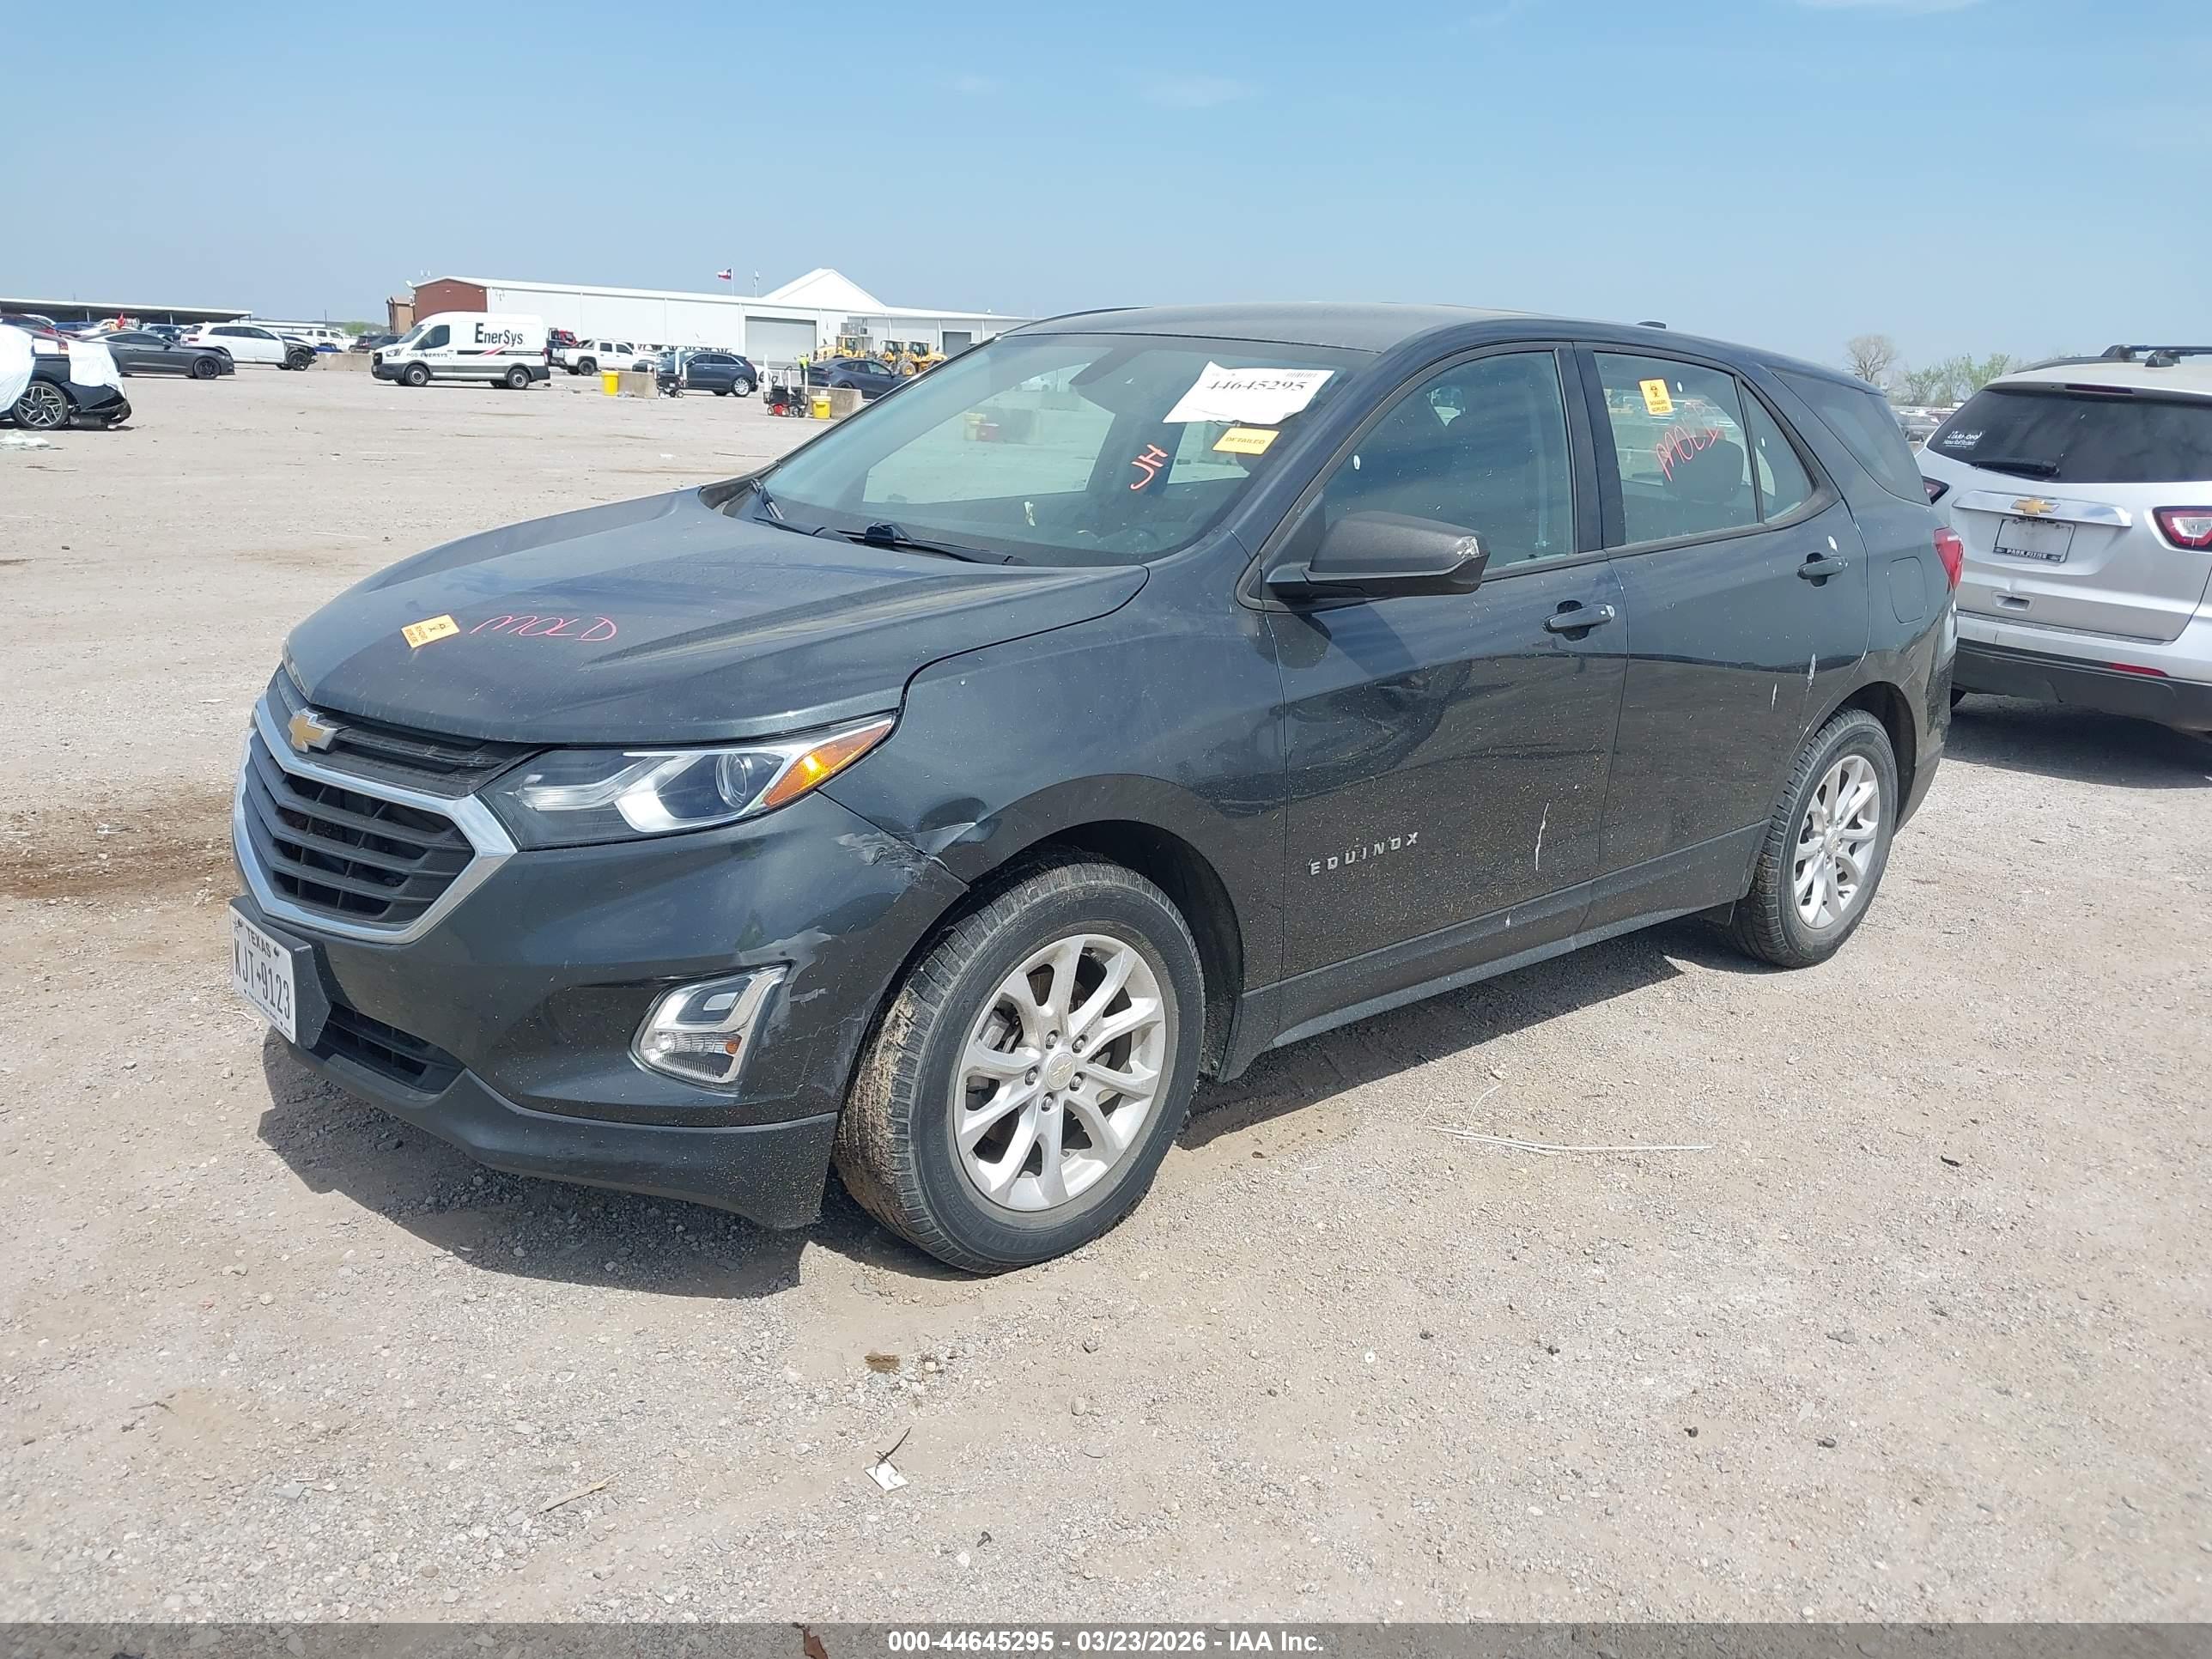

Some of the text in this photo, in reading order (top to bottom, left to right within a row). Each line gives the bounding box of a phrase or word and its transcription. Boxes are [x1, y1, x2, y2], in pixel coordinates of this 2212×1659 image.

[475, 323, 523, 347] EnerSys
[1206, 380, 1308, 391] 44645295
[469, 615, 617, 641] MOLD
[1310, 832, 1419, 876] EQUINOX
[246, 927, 271, 958] TEXAS
